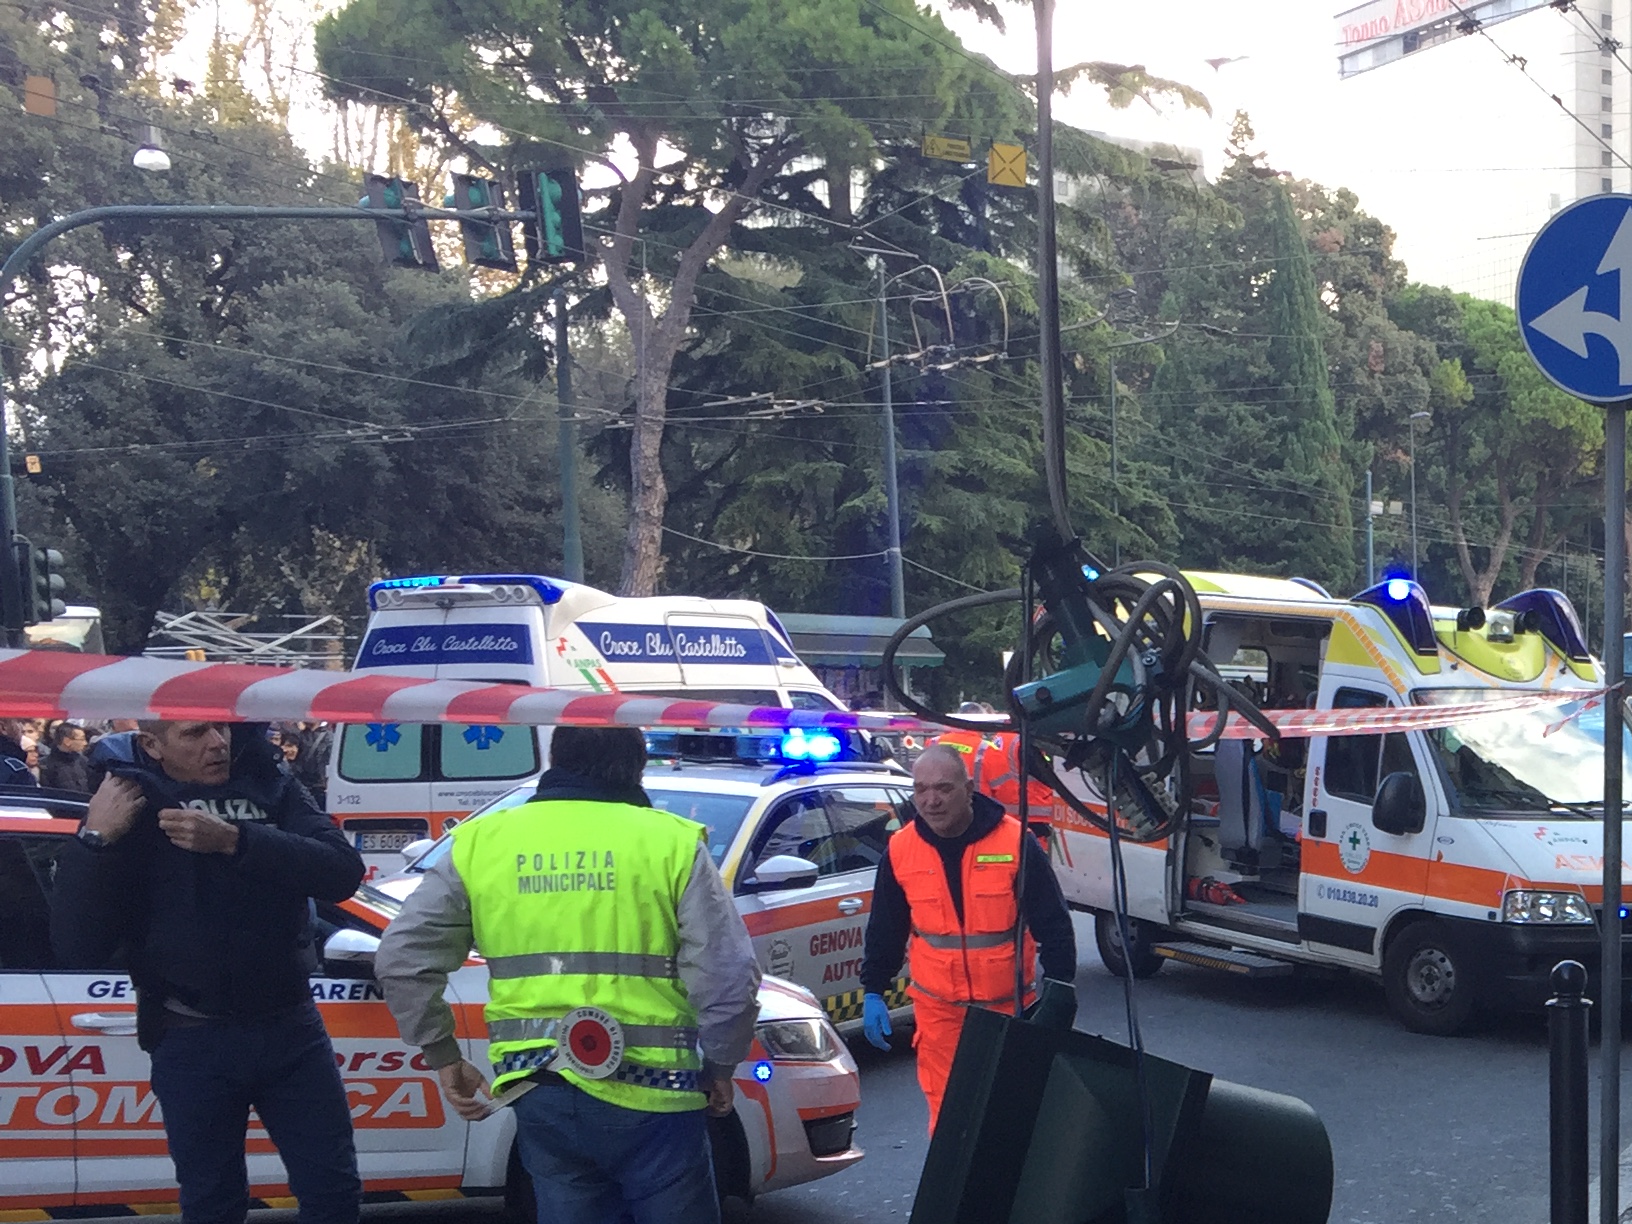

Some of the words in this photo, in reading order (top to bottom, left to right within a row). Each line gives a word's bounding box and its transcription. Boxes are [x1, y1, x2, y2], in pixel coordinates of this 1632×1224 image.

[372, 639, 408, 656] Croce
[410, 636, 438, 652] Blu
[441, 635, 518, 652] Castelletto
[600, 630, 643, 656] Croce
[645, 632, 674, 656] Blu
[675, 633, 747, 658] Castelletto
[516, 850, 614, 872] POLIZIA
[518, 871, 616, 894] MUNICIPALE
[809, 926, 864, 957] GENOVA
